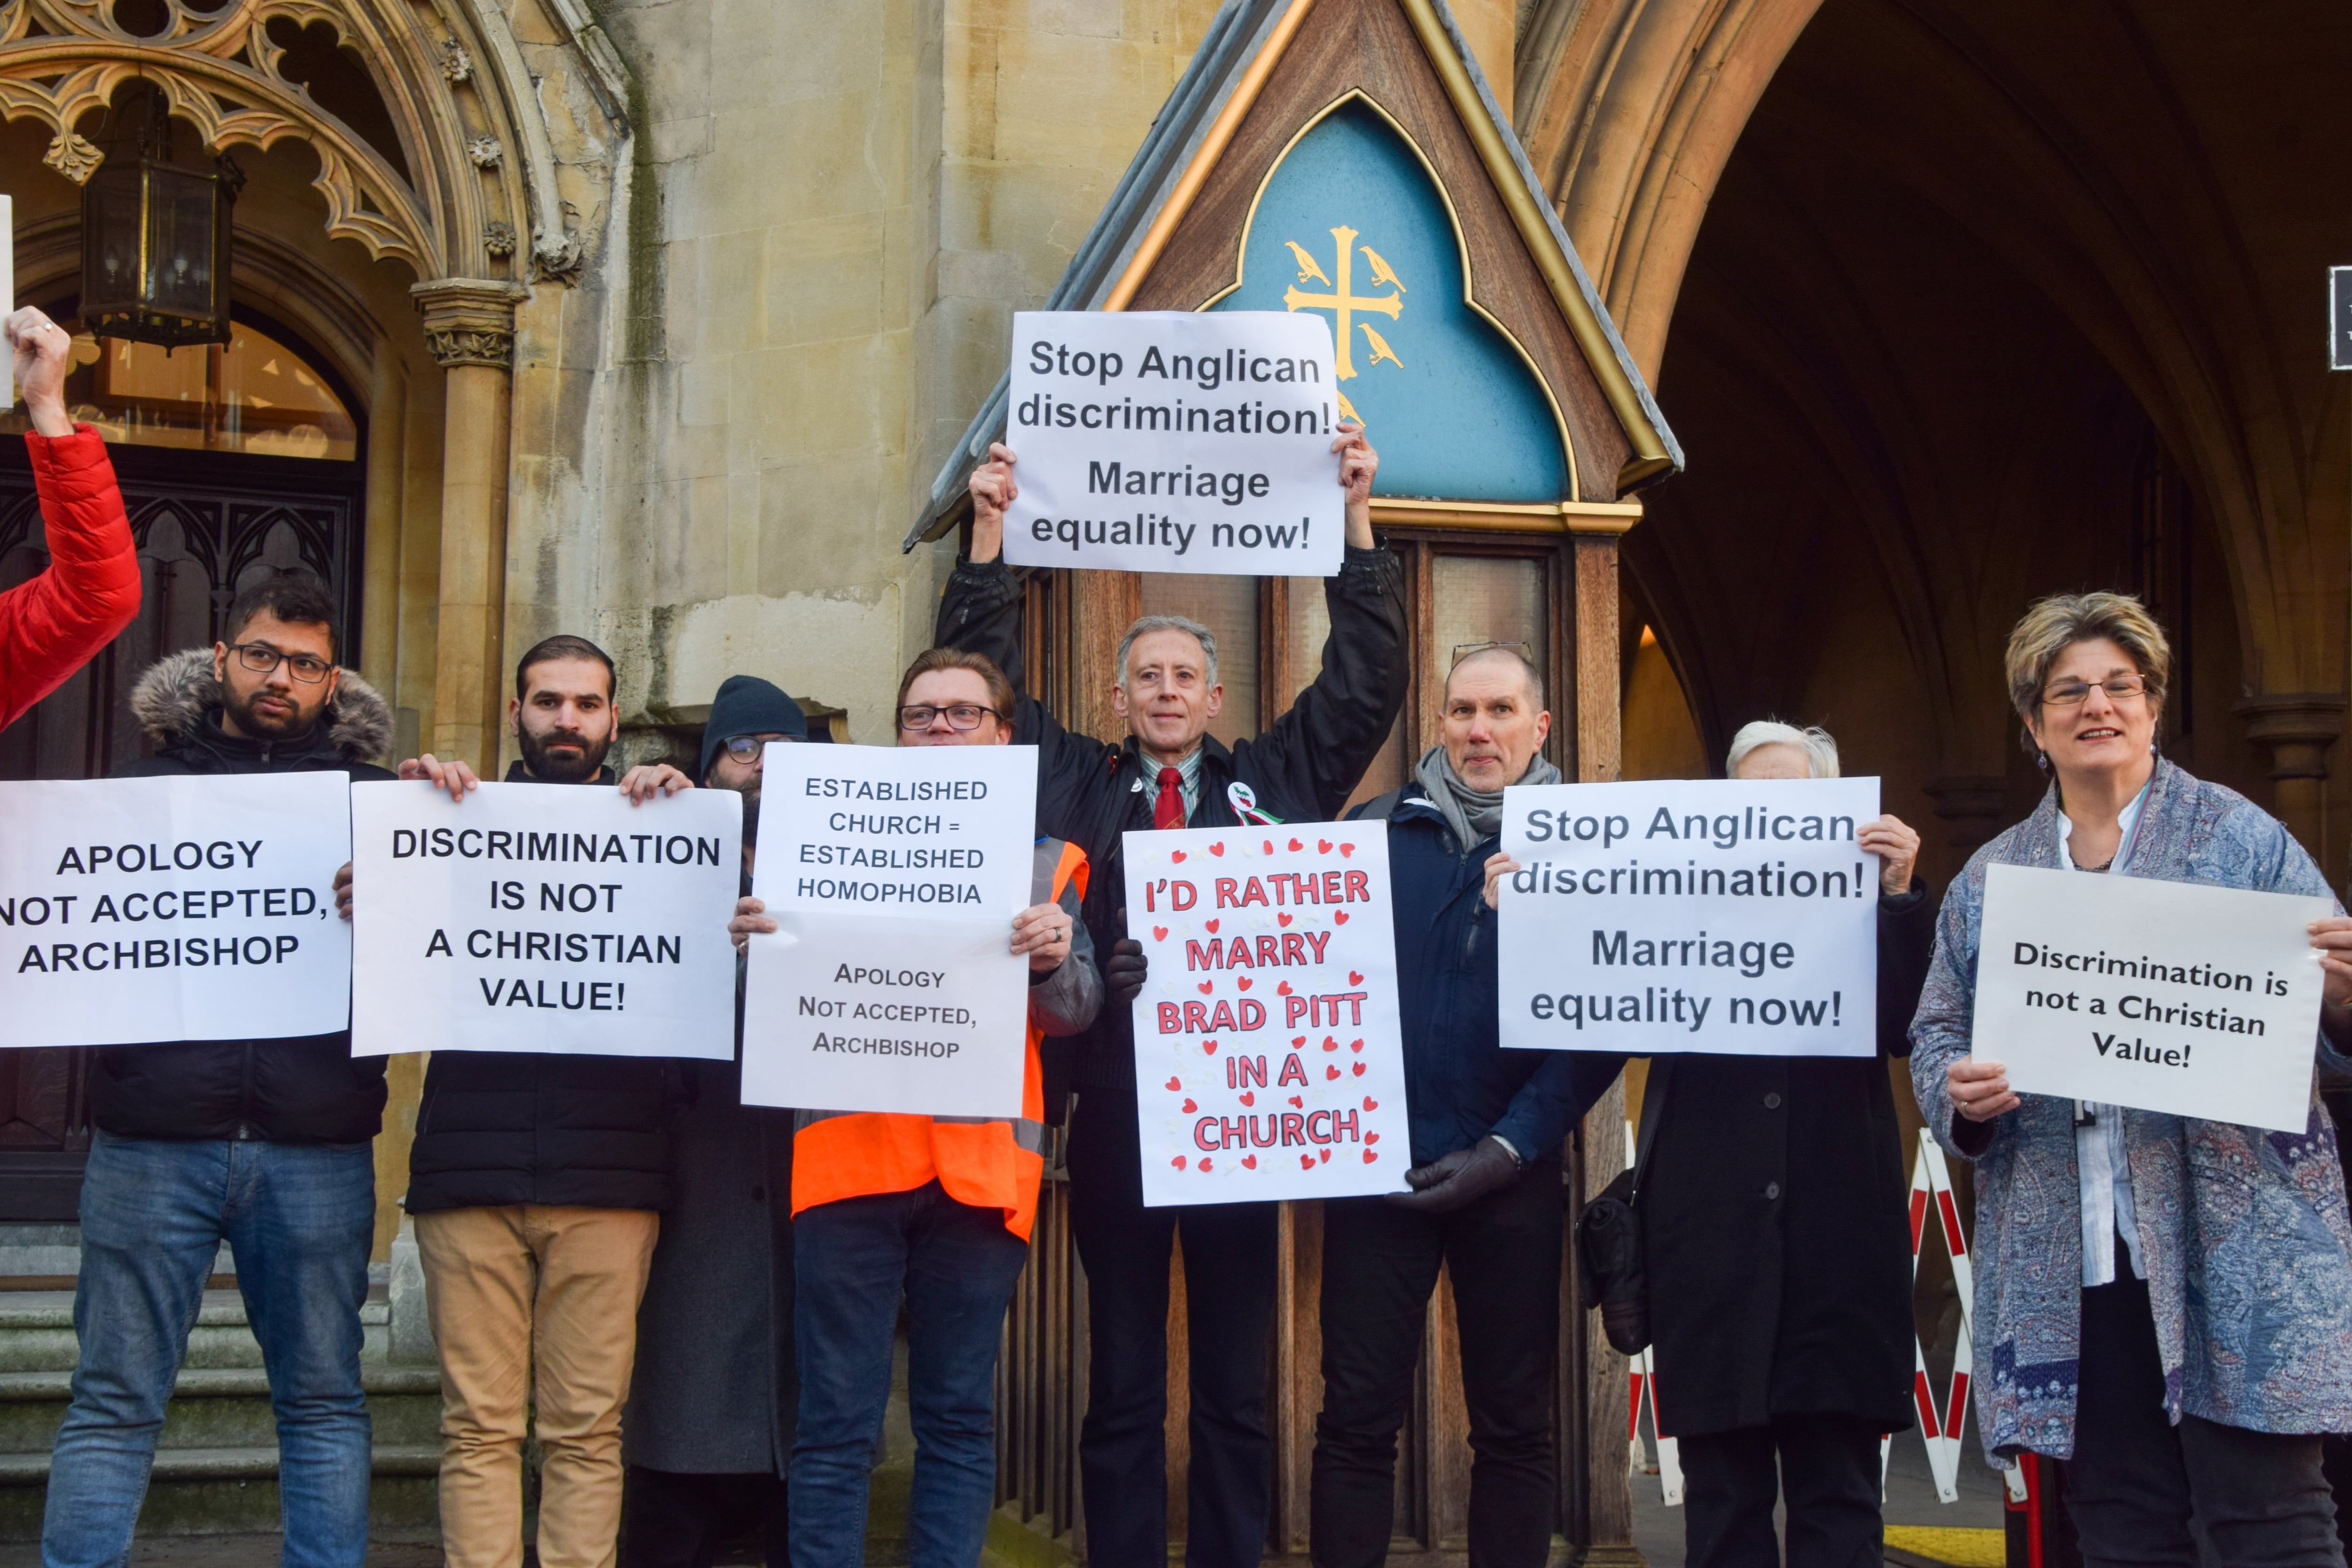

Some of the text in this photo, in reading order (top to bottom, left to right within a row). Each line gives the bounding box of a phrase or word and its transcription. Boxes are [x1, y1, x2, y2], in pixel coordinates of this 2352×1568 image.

[1030, 341, 1319, 390] Stop Anglican
[1018, 393, 1329, 435] discrimination!
[1089, 461, 1270, 506] Marriage
[1032, 513, 1309, 555] equality now!
[806, 778, 987, 801] ESTABLISHED
[829, 812, 940, 834] CHURCH
[1526, 807, 1854, 849] Stop Anglican
[56, 840, 263, 875] APOLOGY
[393, 828, 720, 866] DISCRIMINATION
[800, 844, 984, 868] ESTABLISHED
[491, 880, 622, 913] IS NOT
[798, 878, 982, 904] HOMOPHOBIA
[1215, 870, 1370, 909] RATHER
[1512, 860, 1863, 898] discrimination!
[90, 887, 326, 923] ACCEPTED,
[18, 935, 299, 973] ARCHBISHOP
[425, 929, 681, 964] A CHRISTIAN
[1185, 931, 1331, 971] MARRY
[1593, 930, 1795, 978] Marriage
[2014, 942, 2288, 996] Discrimination is
[479, 978, 624, 1011] VALUE!
[1157, 991, 1368, 1034] BRAD PITT
[1531, 987, 1841, 1032] equality now!
[2026, 989, 2265, 1036] not a Christian
[2092, 1032, 2191, 1068] Value!
[1226, 1053, 1309, 1089] IN A
[1194, 1108, 1359, 1151] CHURCH
